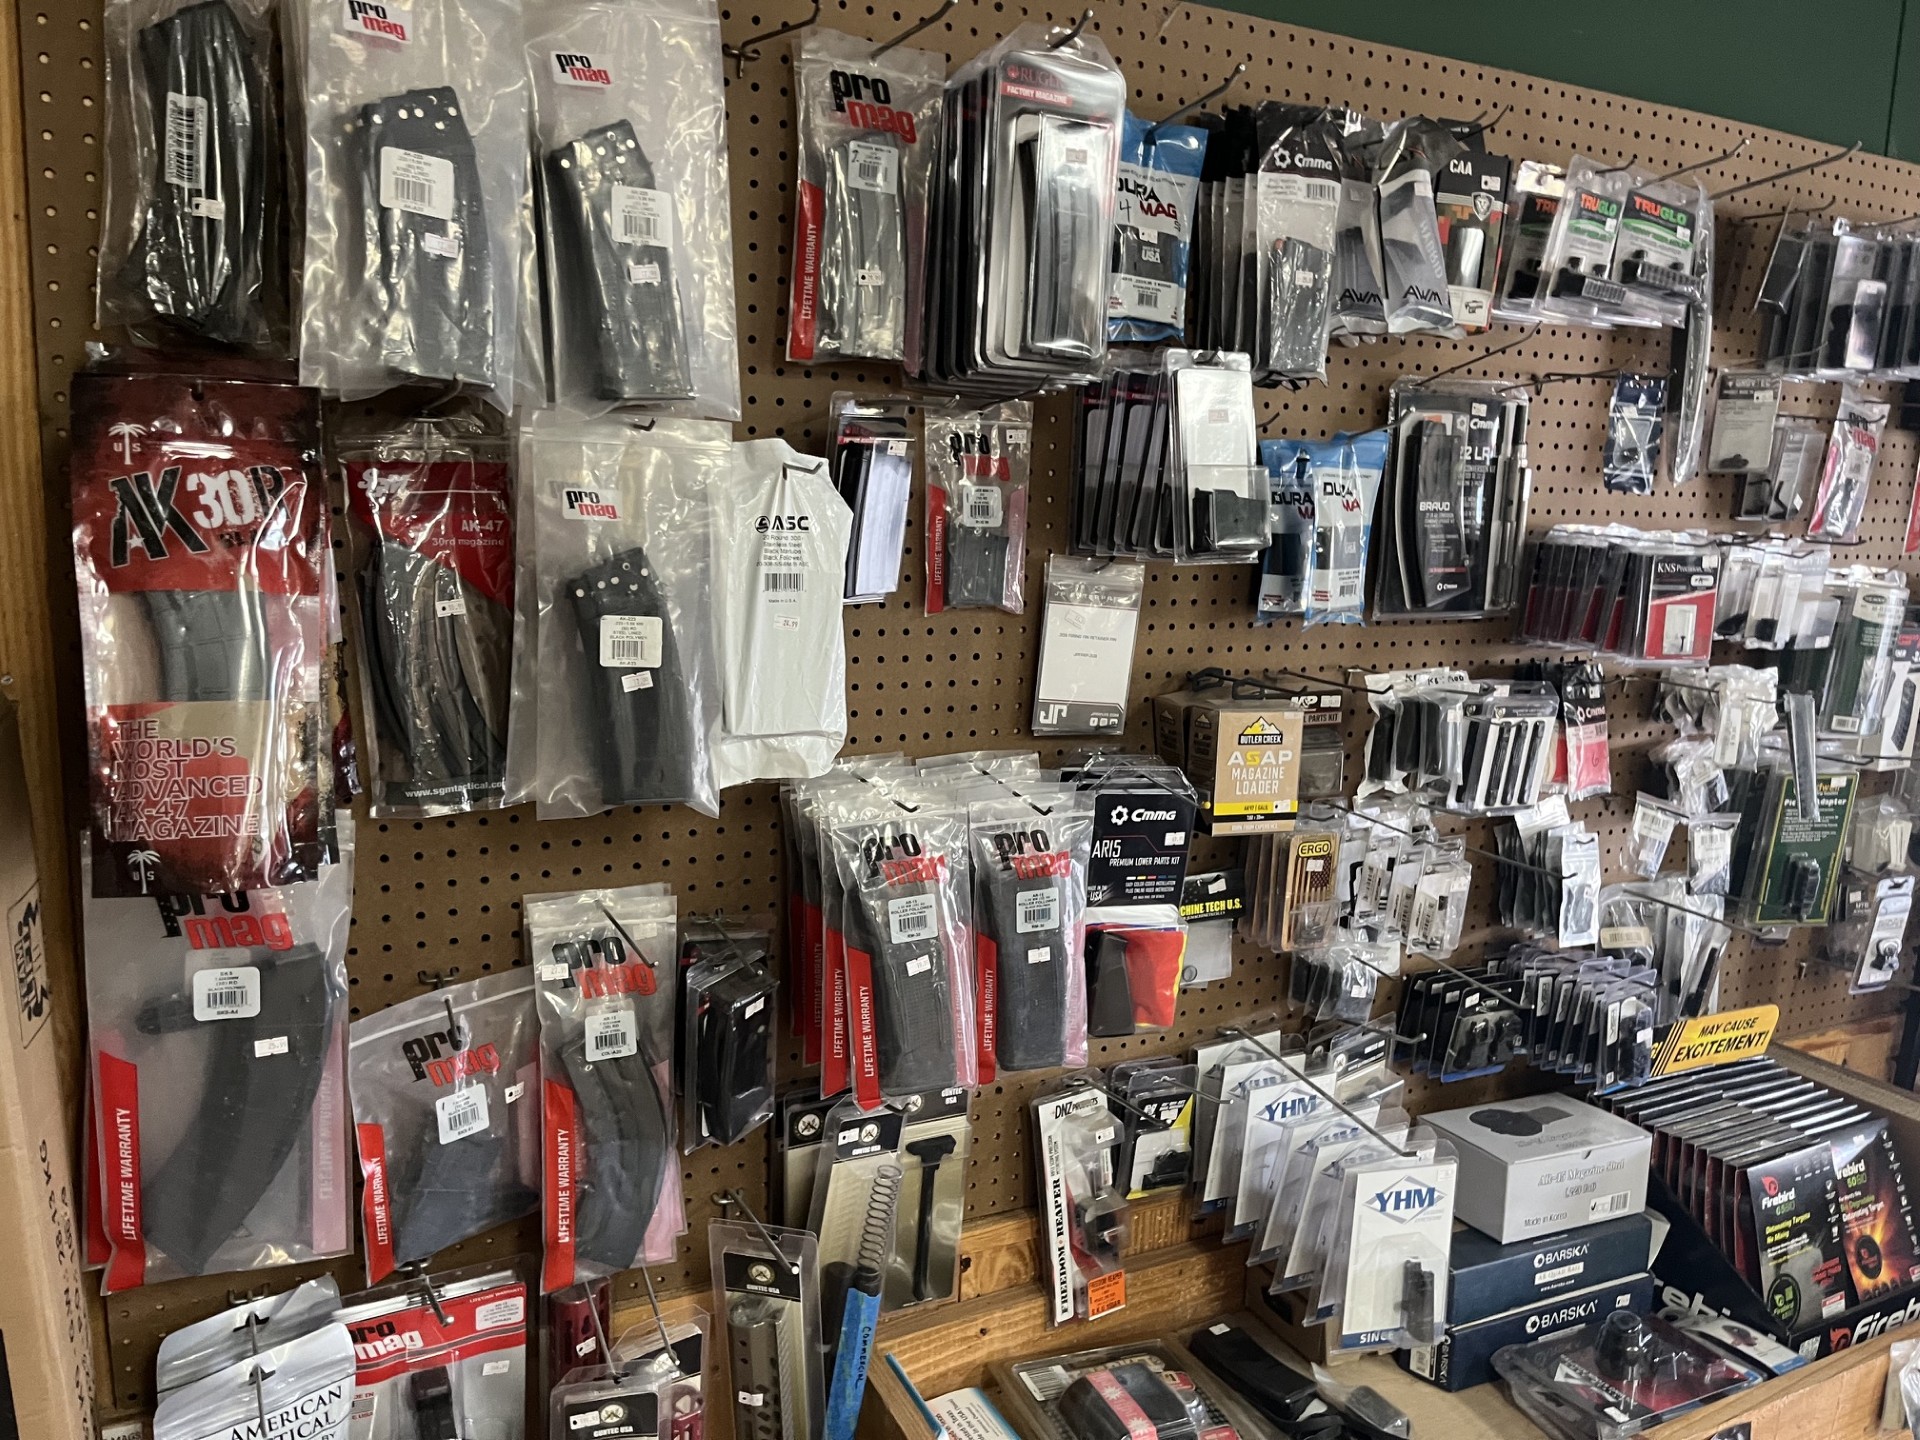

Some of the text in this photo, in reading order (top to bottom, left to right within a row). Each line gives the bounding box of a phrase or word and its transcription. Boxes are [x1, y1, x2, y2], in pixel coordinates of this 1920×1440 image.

[347, 0, 388, 20] pro
[362, 16, 407, 40] mag
[555, 54, 592, 73] pro
[569, 67, 612, 85] mag
[830, 70, 891, 112] pro
[846, 101, 917, 144] mag
[1449, 158, 1474, 176] CAA
[1140, 199, 1178, 220] MAG
[1581, 193, 1617, 217] TRUGLO
[1634, 196, 1688, 226] TRUGLO
[1142, 250, 1161, 264] USA
[802, 223, 817, 320] LIFETIME WARRANTY
[565, 490, 600, 509] pro
[1419, 501, 1451, 512] BRAVO
[108, 465, 210, 569] AK
[578, 503, 618, 520] mag
[771, 515, 810, 531] ASC
[461, 520, 505, 532] AK-47
[457, 537, 505, 548] magazine
[934, 515, 944, 584] LIFETIME WARRANTY
[1657, 563, 1677, 573] KNS
[1308, 713, 1338, 722] PARTS KIT
[119, 719, 160, 740] THE
[1240, 734, 1282, 744] BUTLER CREEK
[113, 737, 236, 762] WORLD'S
[1227, 750, 1293, 766] ASAP
[115, 759, 188, 782] MOST
[1231, 766, 1285, 781] MAGAZINE
[114, 776, 263, 802] ADVANCED
[1235, 779, 1280, 795] LOADER
[114, 799, 190, 822] AK-47
[861, 833, 921, 877] pro
[993, 828, 1050, 871] pro
[1299, 841, 1329, 855] ERGO
[1109, 856, 1180, 867] PREMIUM LOWER PARTS KIT
[1205, 901, 1226, 914] TECH
[1227, 898, 1243, 910] U.S.
[183, 913, 294, 950] mag
[576, 965, 657, 999] mag
[833, 967, 842, 1059] LIFETIME WARRANTY
[983, 969, 994, 1052] LIFETIME WARRANTY
[858, 985, 874, 1077] LIFETIME WARRANTY
[1699, 1017, 1759, 1038] MAY CAUSE
[1672, 1031, 1769, 1064] EXCITEMENT!
[1054, 1102, 1073, 1119] DNZ
[1265, 1094, 1317, 1121] YHM
[116, 1108, 138, 1241] LIFETIME WARRANTY
[558, 1128, 571, 1244] LIFETIME WARRANTY
[372, 1157, 389, 1246] LIFETIME WARRANTY
[1053, 1178, 1065, 1238] REAPER
[1375, 1187, 1436, 1213] YHM
[1761, 1187, 1796, 1211] Firebird
[1524, 1217, 1542, 1227] Made
[1545, 1245, 1588, 1265] BARSKA
[1057, 1246, 1069, 1314] FREEDOM
[1541, 1301, 1596, 1326] BARSKA
[356, 1330, 424, 1359] mag
